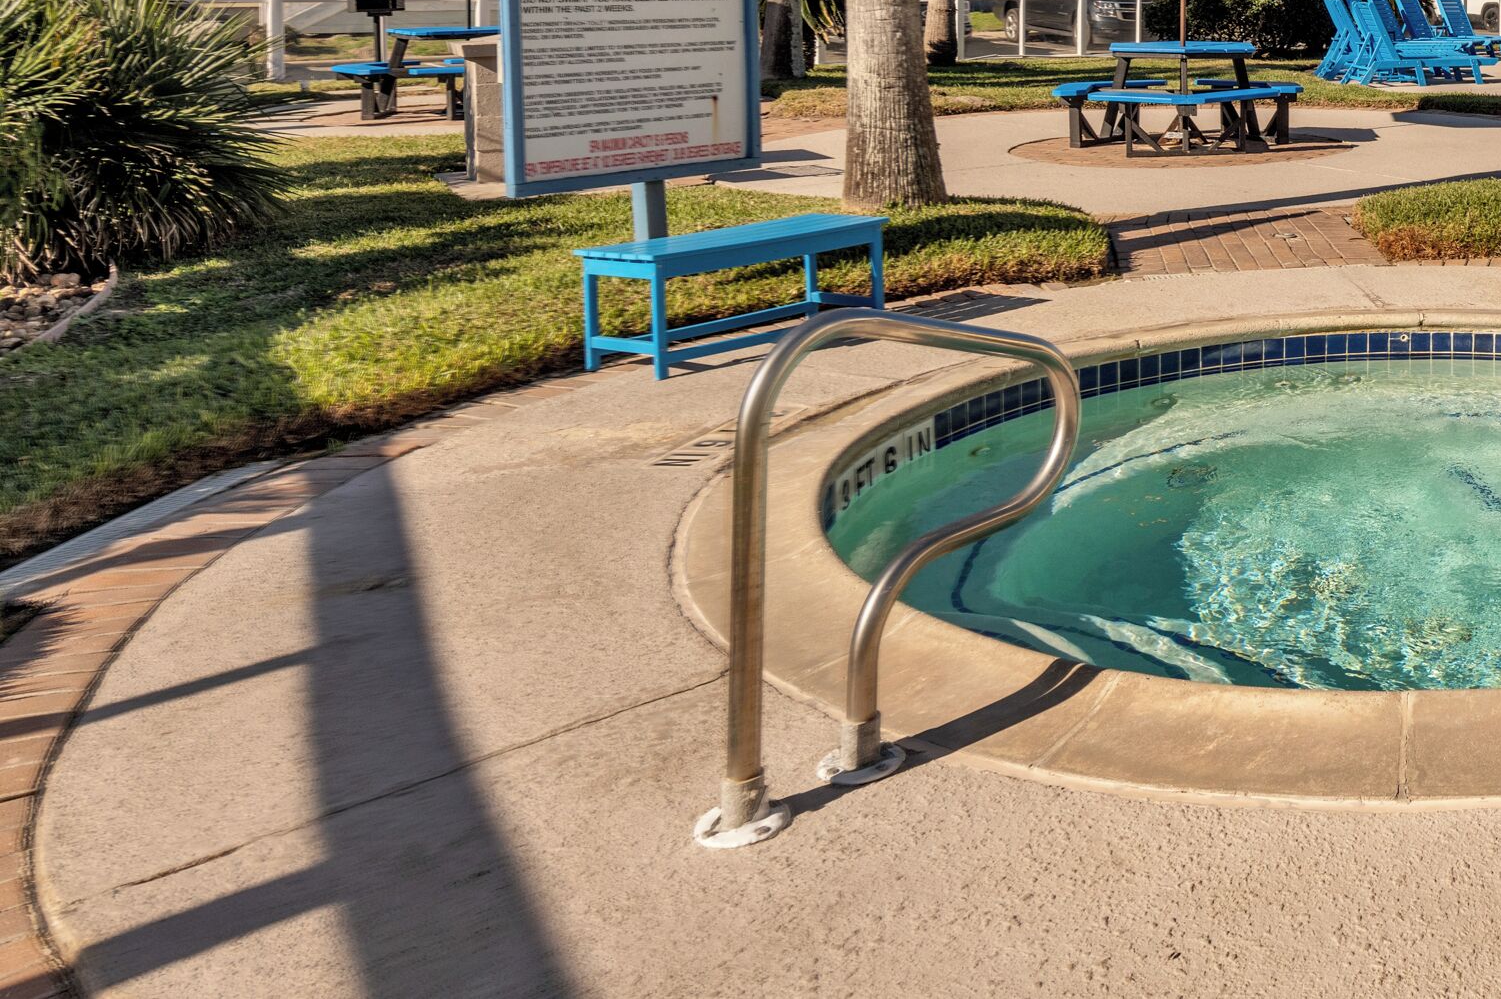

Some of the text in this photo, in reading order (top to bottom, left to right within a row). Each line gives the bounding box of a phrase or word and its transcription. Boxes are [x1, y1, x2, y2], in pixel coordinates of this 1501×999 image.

[523, 6, 553, 14] WITHIN
[574, 5, 595, 13] PAST
[856, 456, 875, 497] FT
[884, 445, 898, 475] 6
[906, 426, 931, 462] IN
